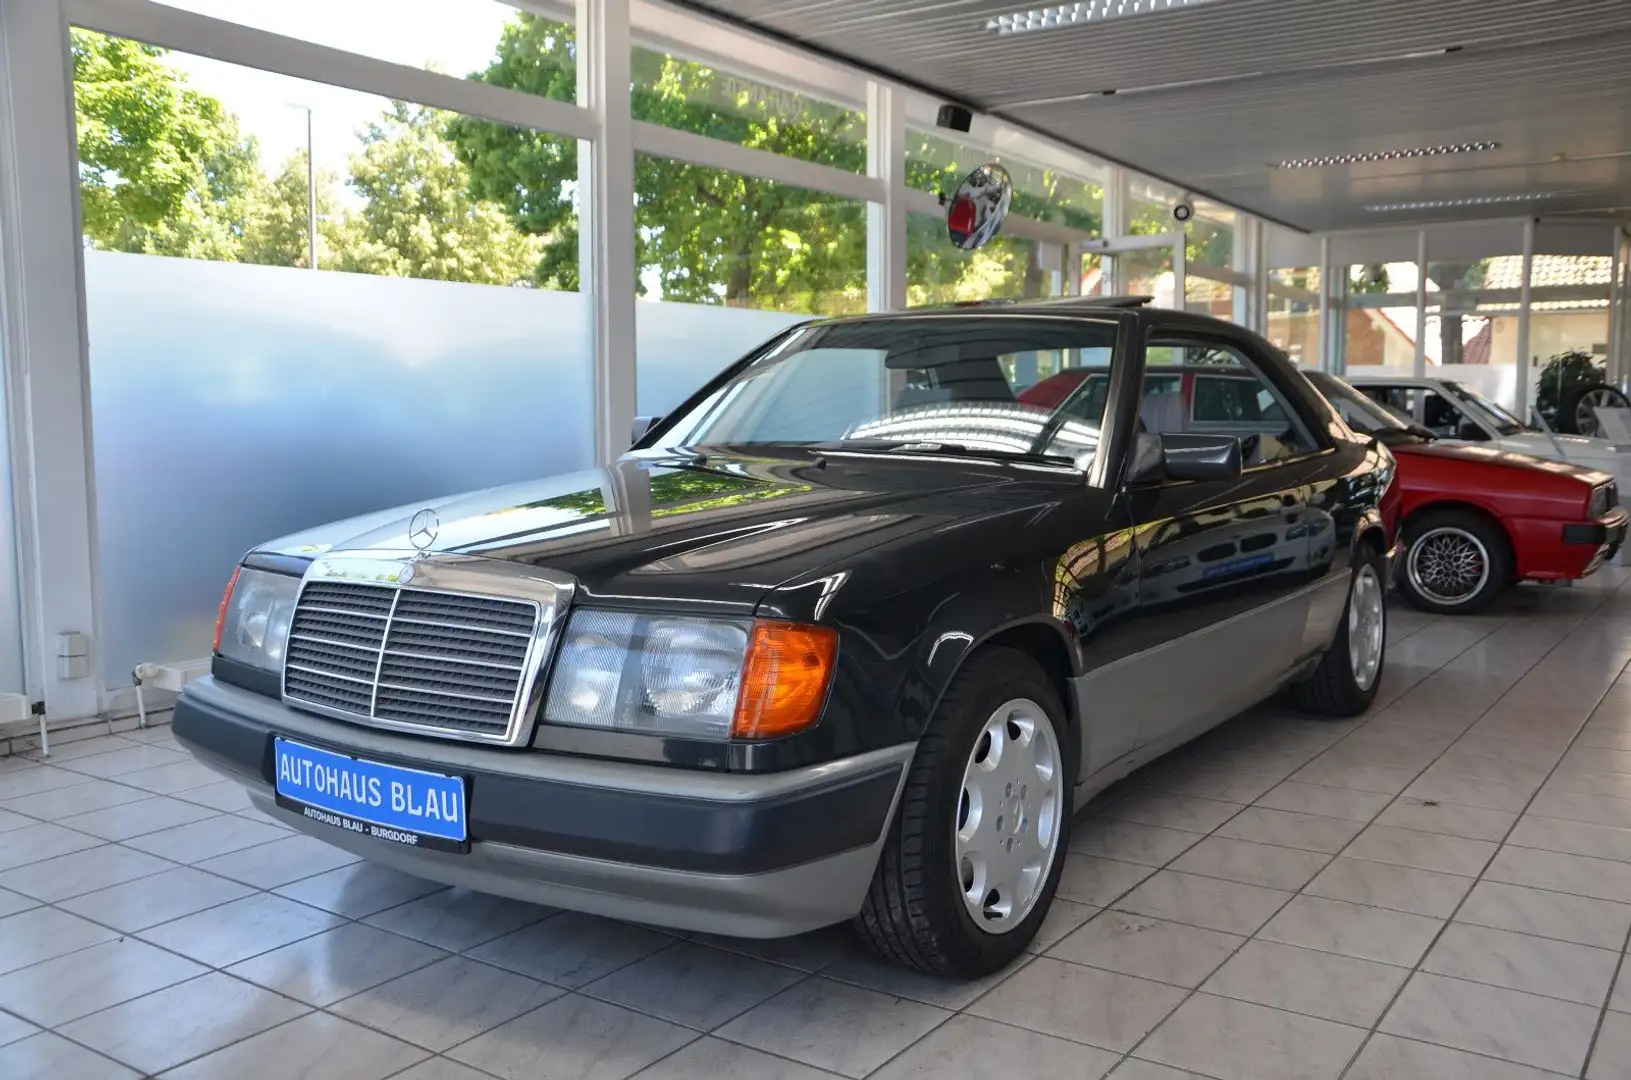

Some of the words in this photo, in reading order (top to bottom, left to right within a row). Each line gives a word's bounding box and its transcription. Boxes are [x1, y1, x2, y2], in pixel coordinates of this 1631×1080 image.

[280, 753, 382, 807] AUTOHAUS
[391, 781, 458, 823] BLAU
[303, 806, 342, 827] AUTOHAUS
[342, 818, 363, 832] BLAU
[371, 826, 418, 845] BURGDORF
